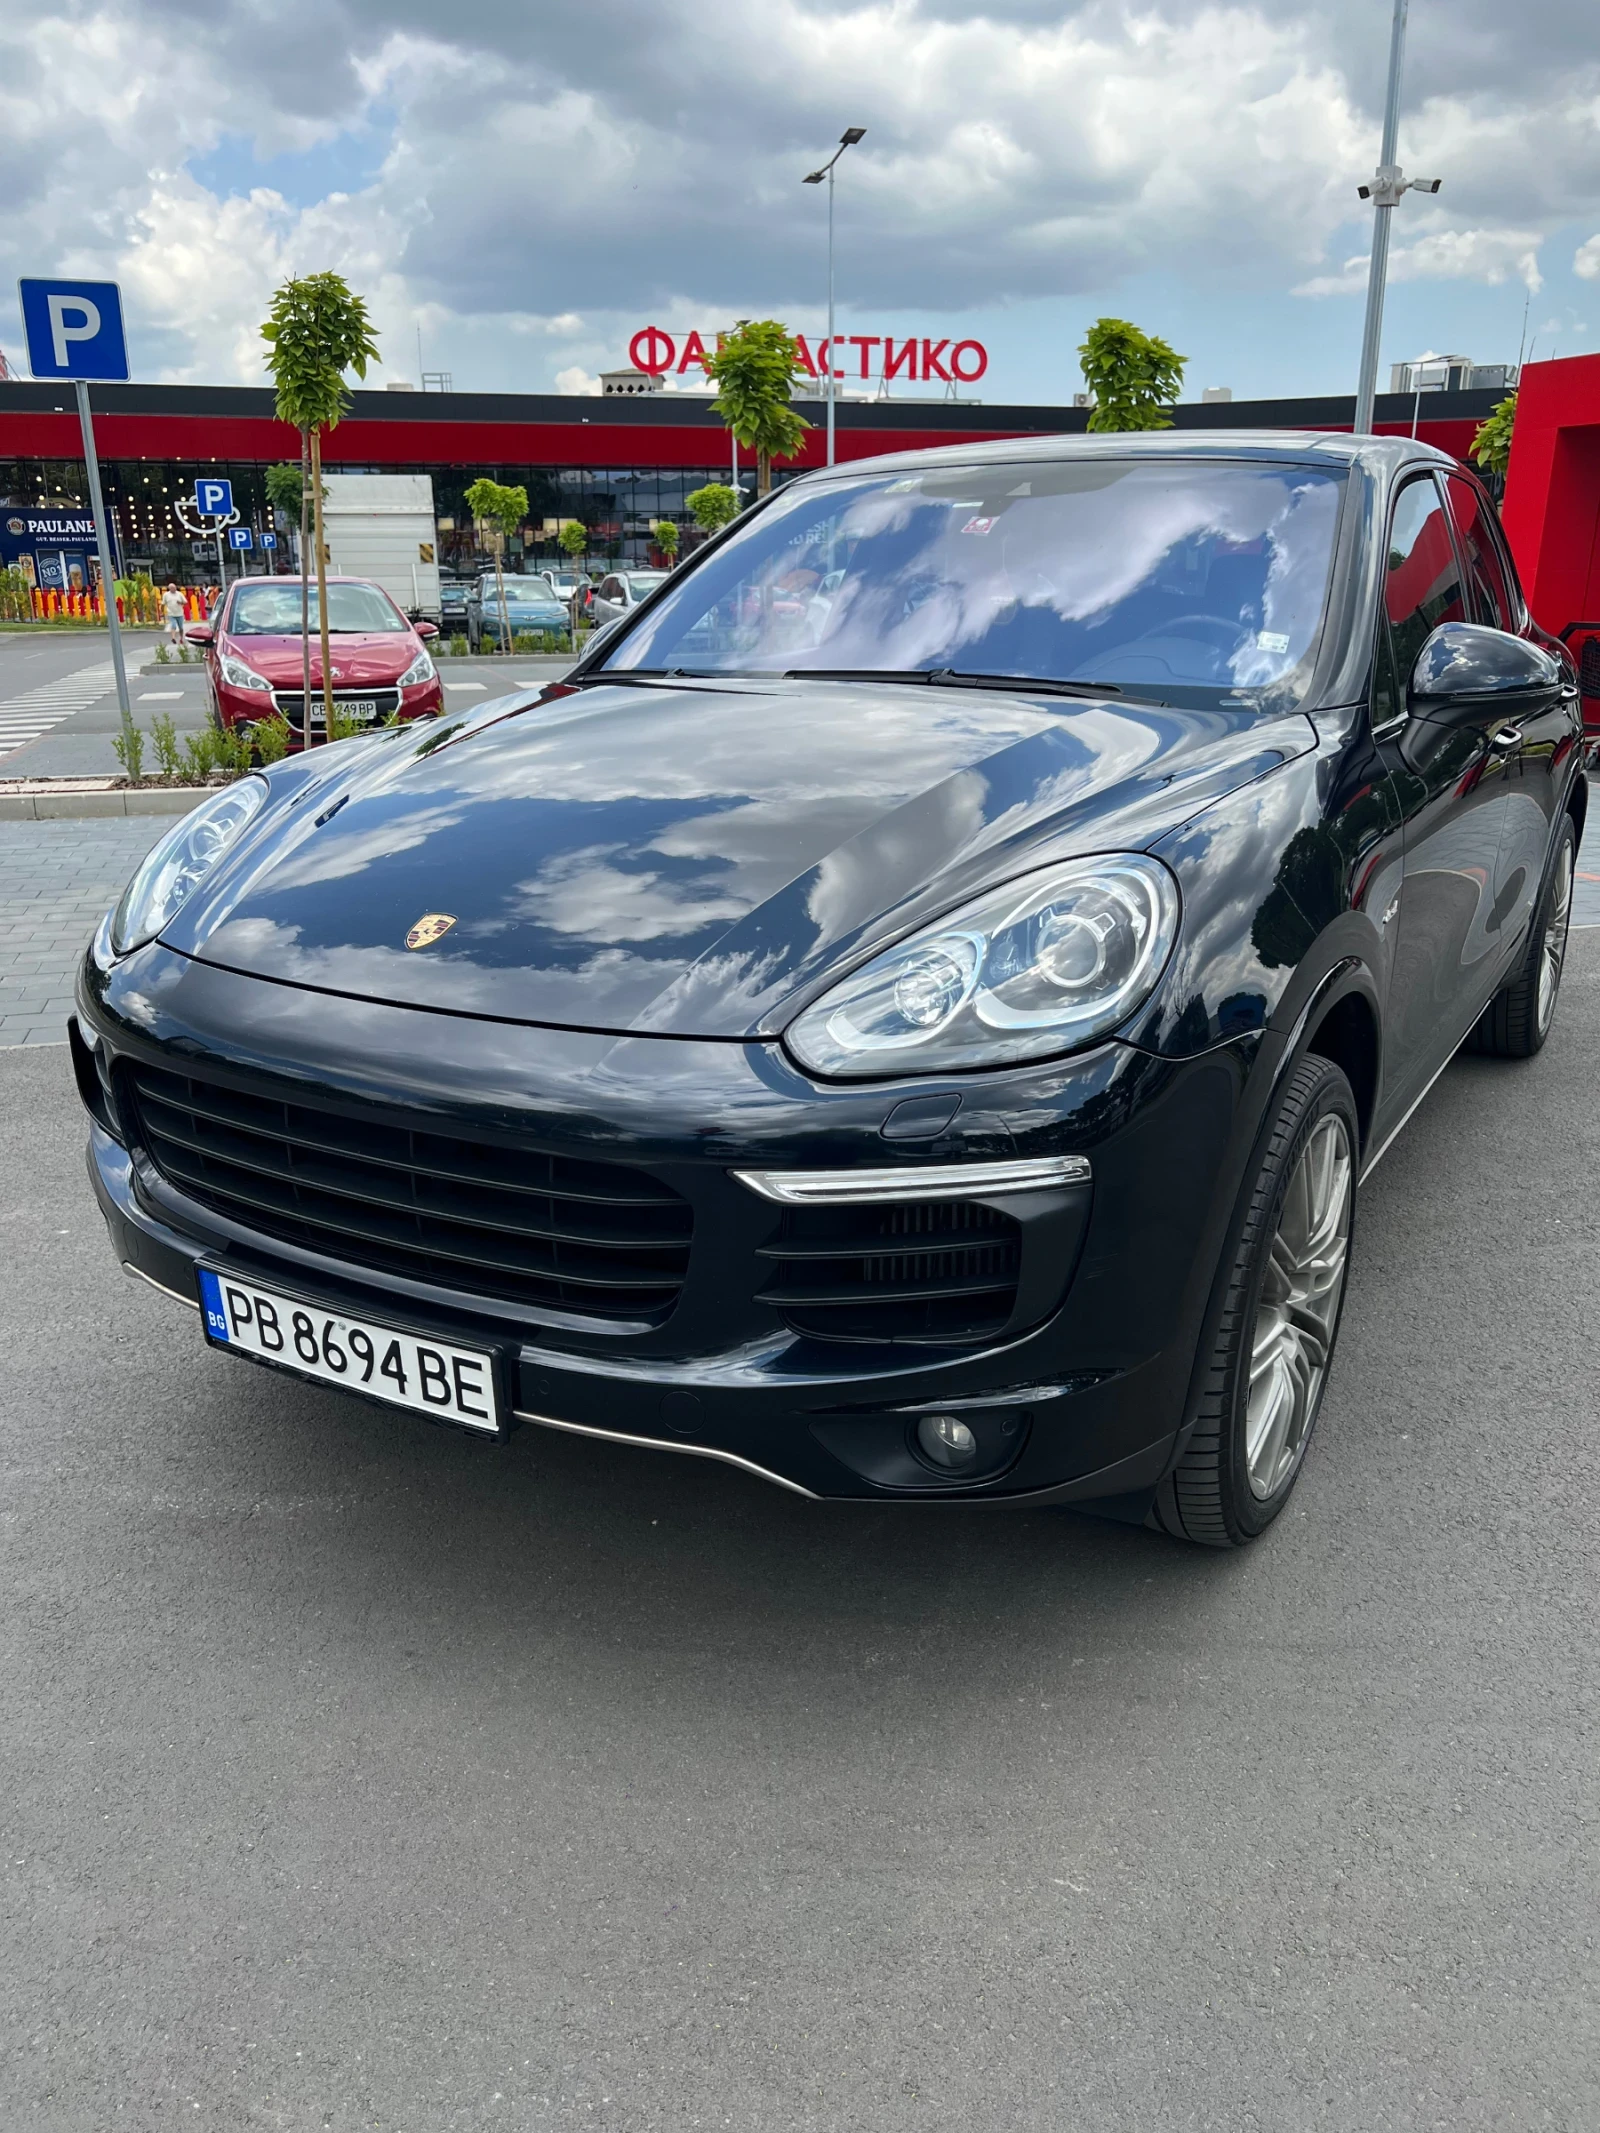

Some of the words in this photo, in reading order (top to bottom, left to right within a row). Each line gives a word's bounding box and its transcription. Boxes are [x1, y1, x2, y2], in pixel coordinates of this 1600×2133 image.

[47, 294, 101, 367] P
[629, 326, 988, 382] ФААСТИКО
[204, 485, 224, 511] P
[234, 531, 247, 547] P
[263, 535, 273, 547] P
[208, 1310, 225, 1330] BG
[226, 1285, 284, 1351] PB
[292, 1310, 409, 1395] 8694
[416, 1346, 489, 1420] BE
